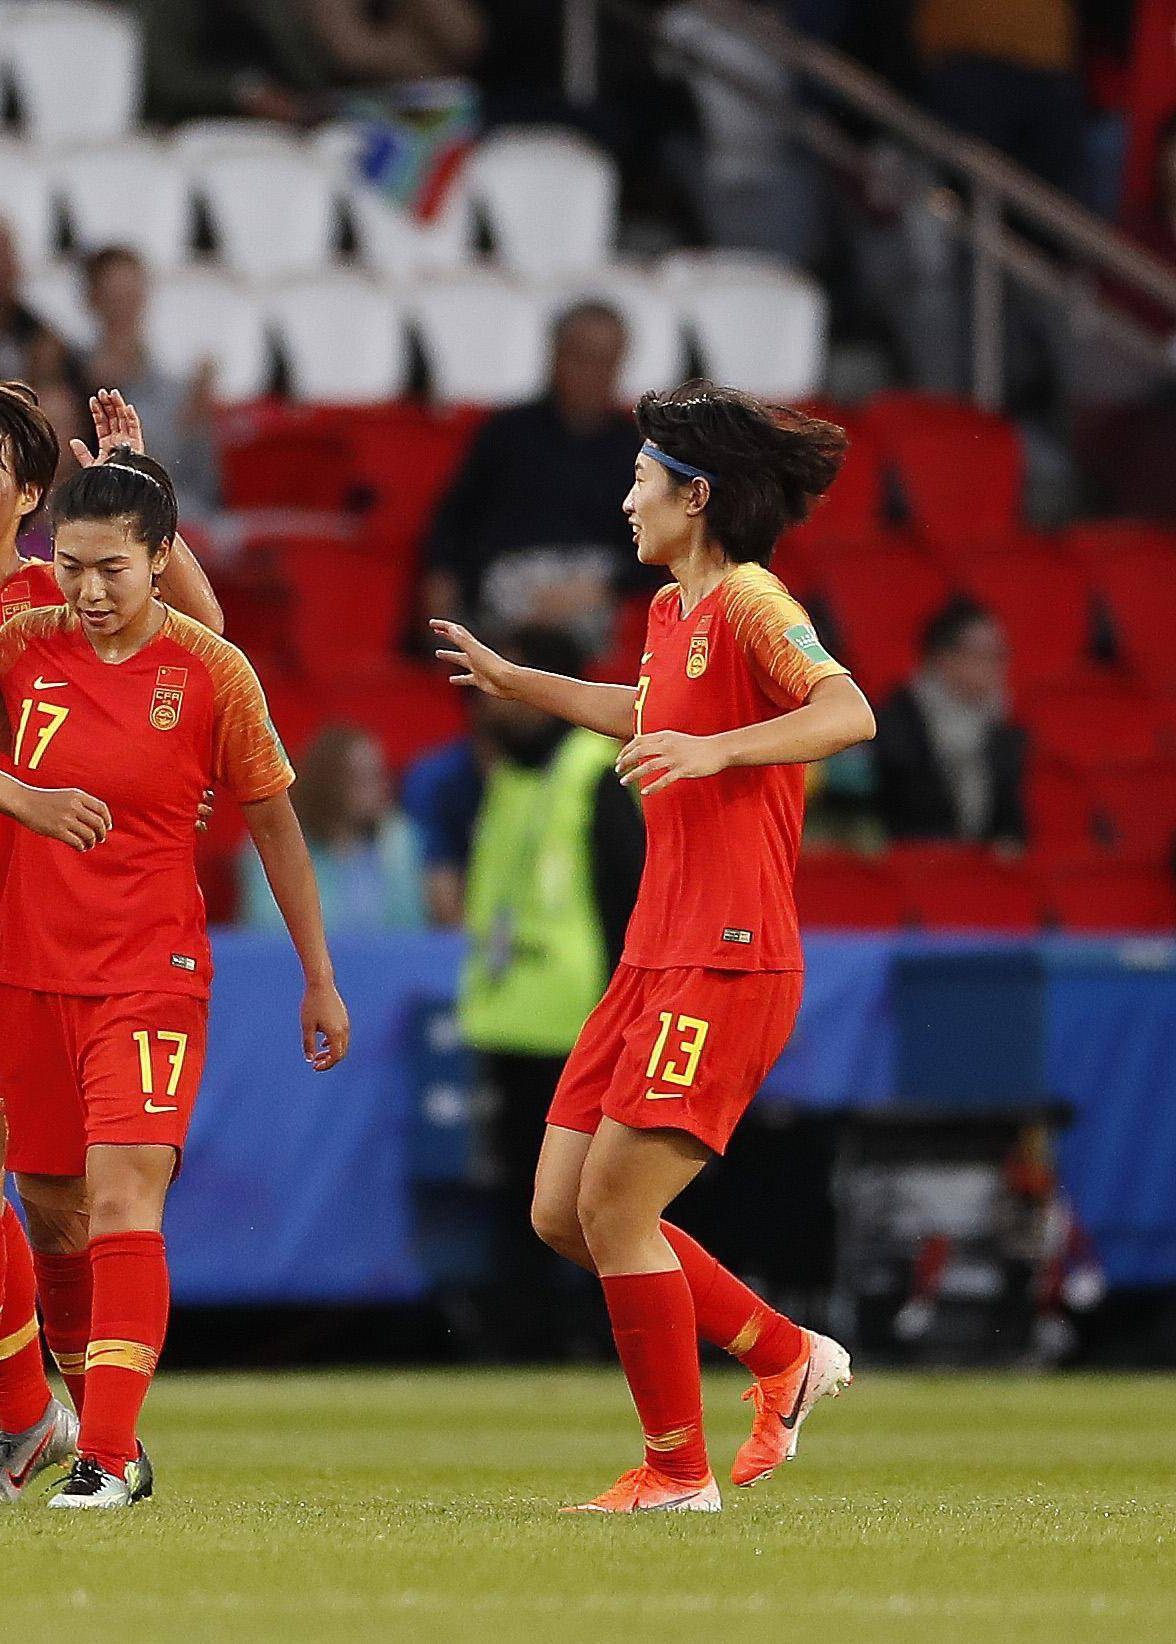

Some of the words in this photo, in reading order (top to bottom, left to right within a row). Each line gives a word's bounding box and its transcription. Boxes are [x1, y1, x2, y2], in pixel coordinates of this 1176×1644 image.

[155, 690, 180, 701] CFA
[13, 698, 70, 770] 17
[132, 1030, 188, 1096] 17
[645, 1011, 709, 1087] 13
